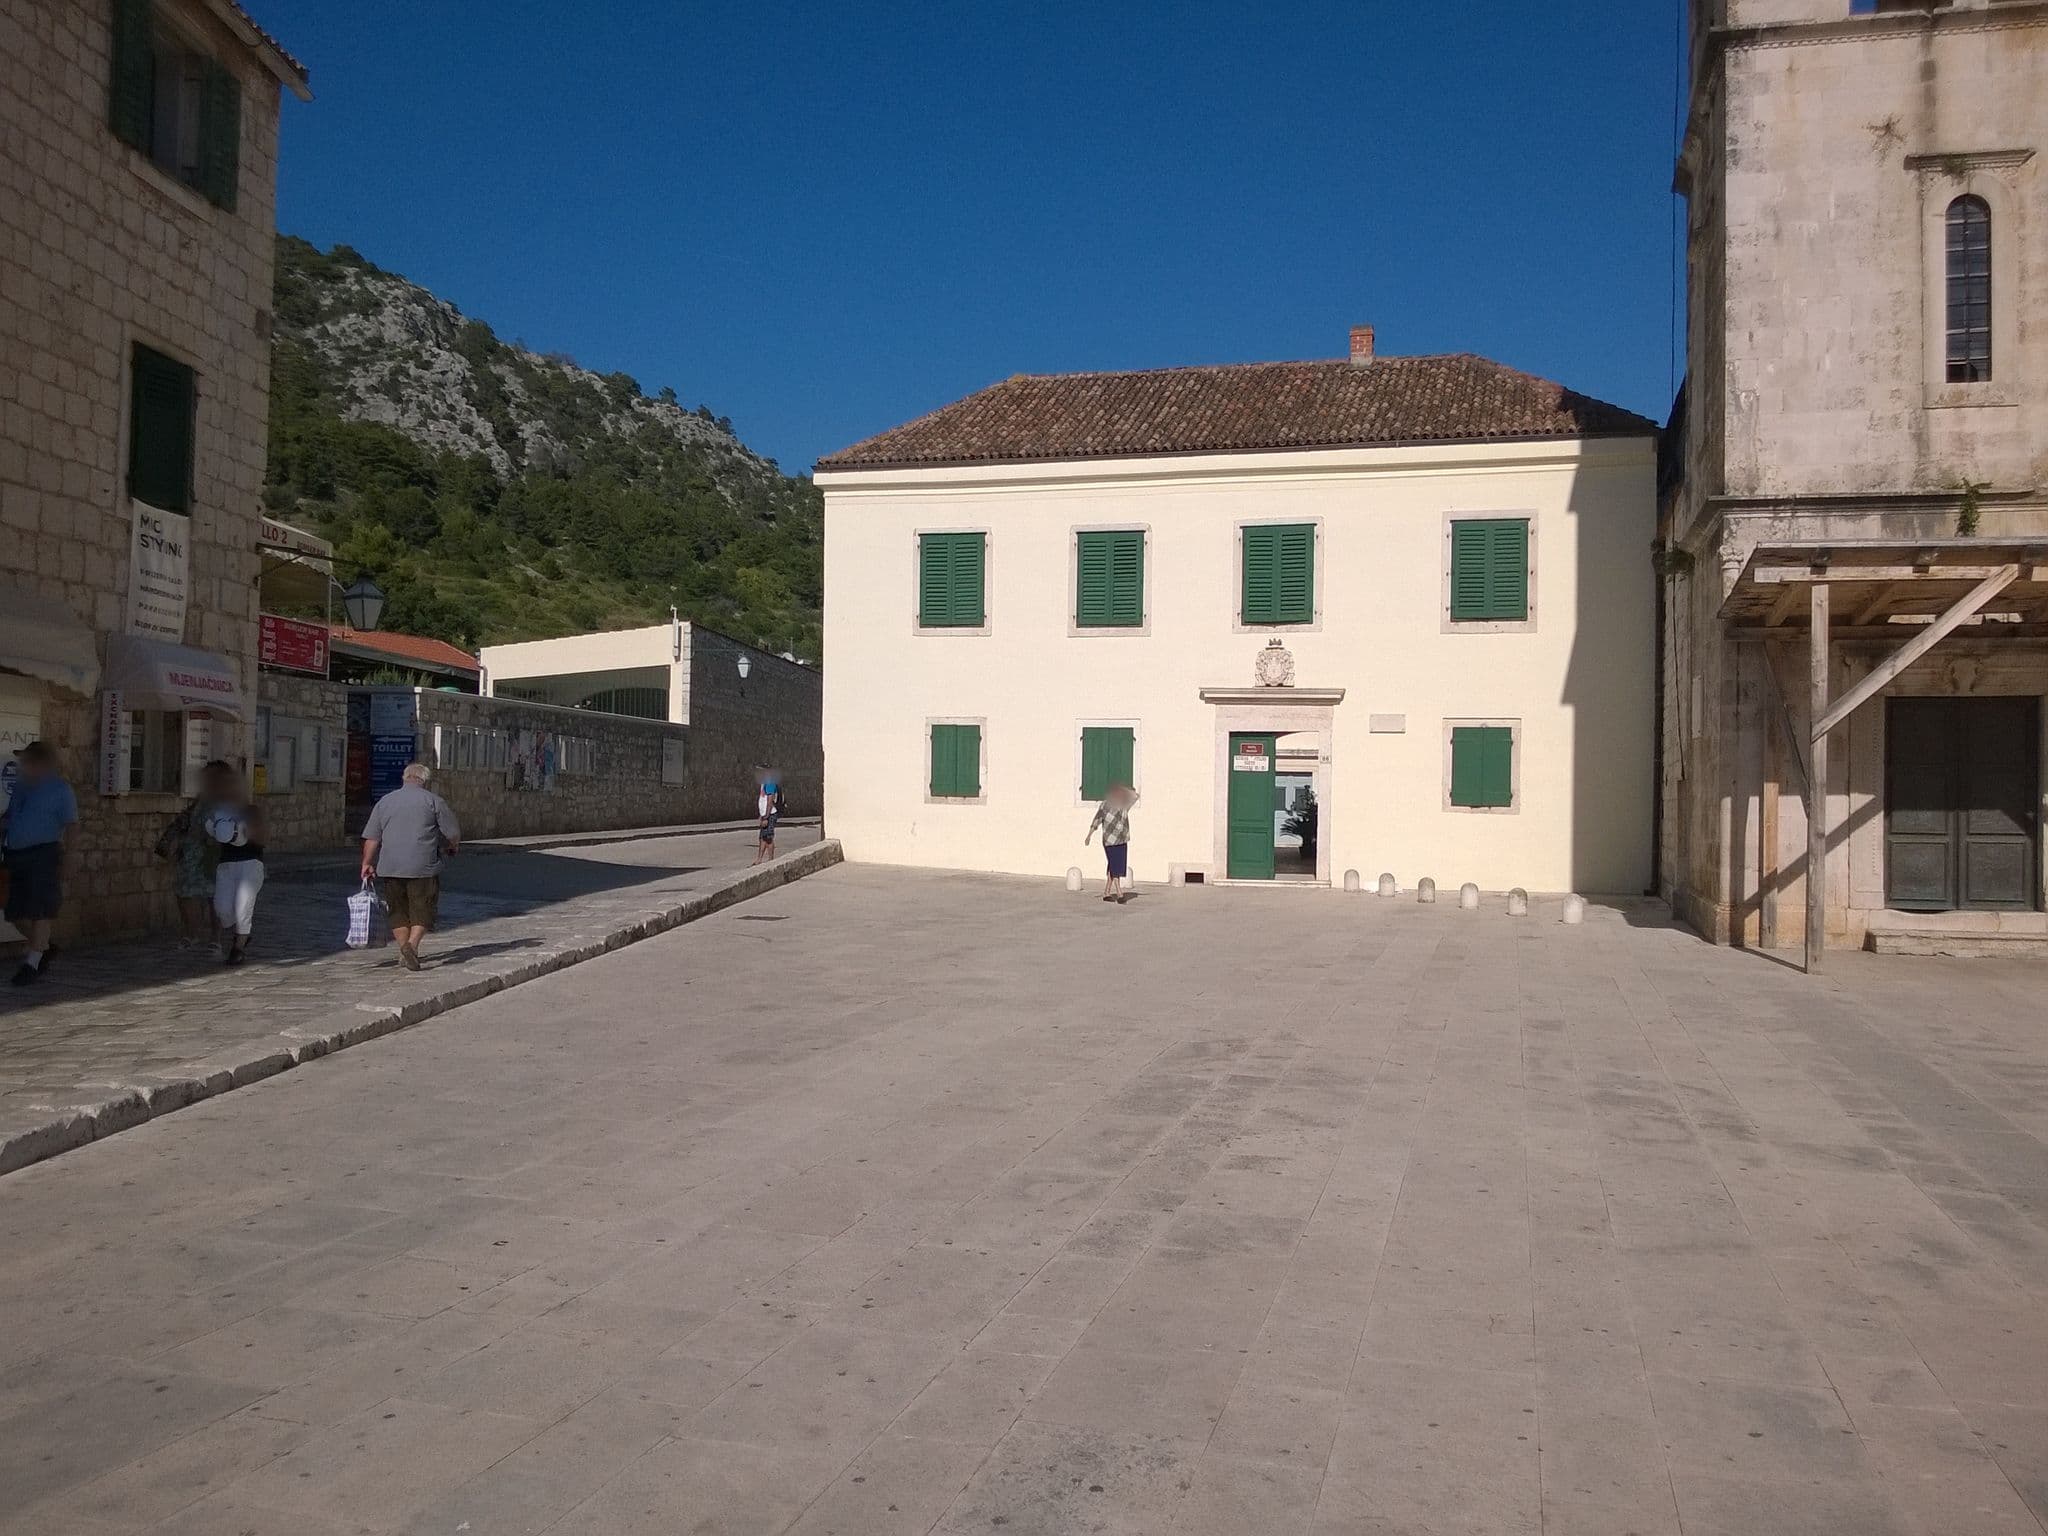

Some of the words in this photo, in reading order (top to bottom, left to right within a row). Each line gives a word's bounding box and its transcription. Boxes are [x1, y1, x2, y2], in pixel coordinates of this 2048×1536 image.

[140, 533, 183, 558] STYING
[281, 531, 288, 545] 2
[108, 693, 118, 746] EXCHANGE
